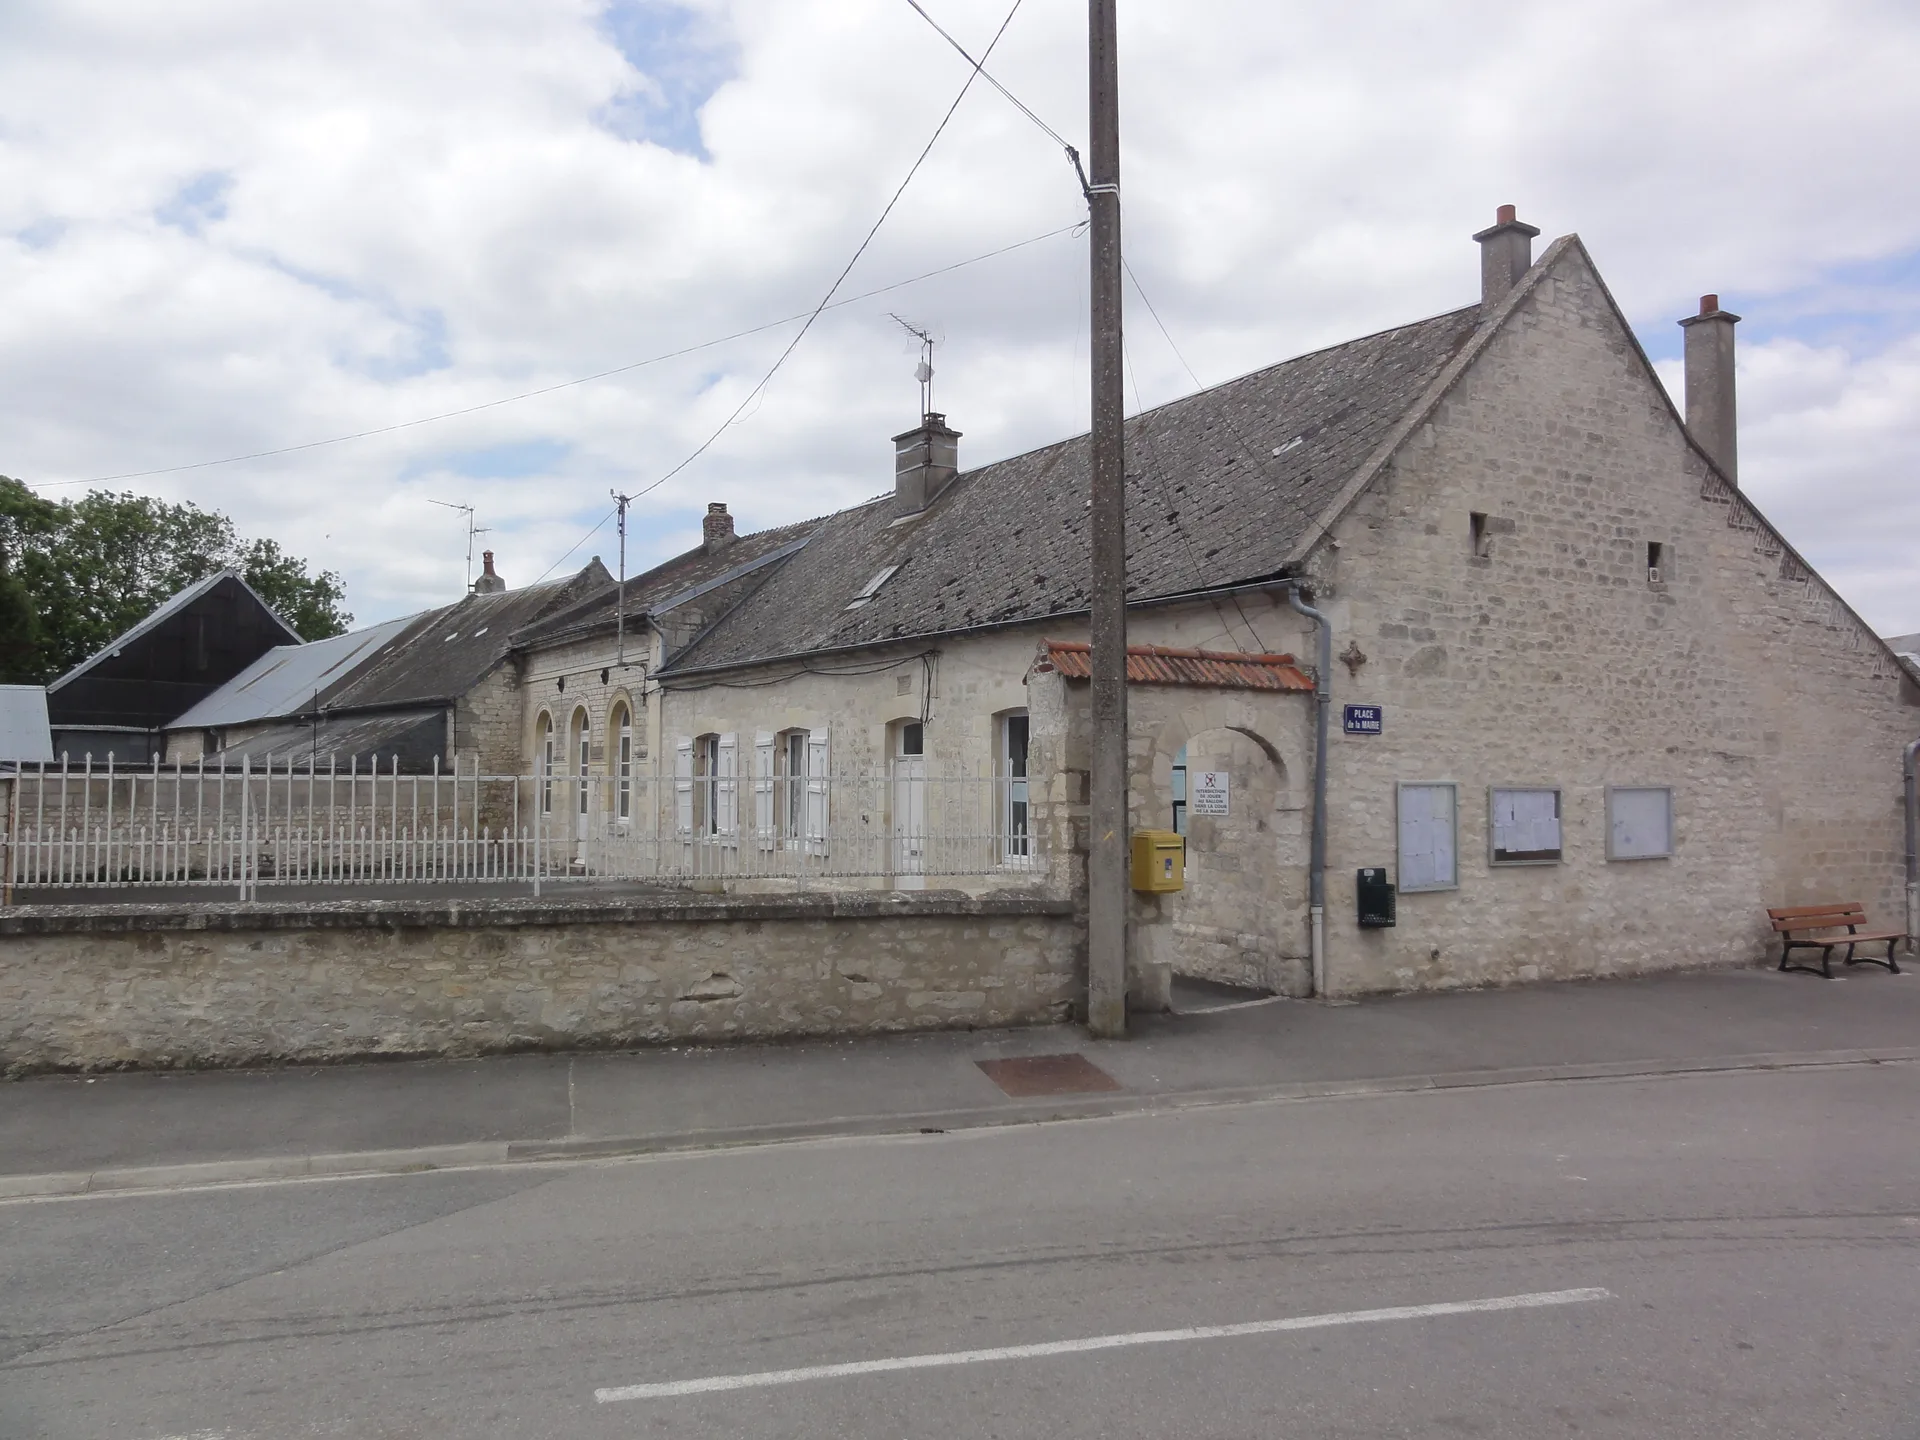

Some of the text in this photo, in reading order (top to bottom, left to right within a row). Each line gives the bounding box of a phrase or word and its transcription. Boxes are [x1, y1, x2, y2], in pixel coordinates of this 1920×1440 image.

[1354, 709, 1374, 719] PLACE
[1347, 719, 1380, 730] de la MAIRIE
